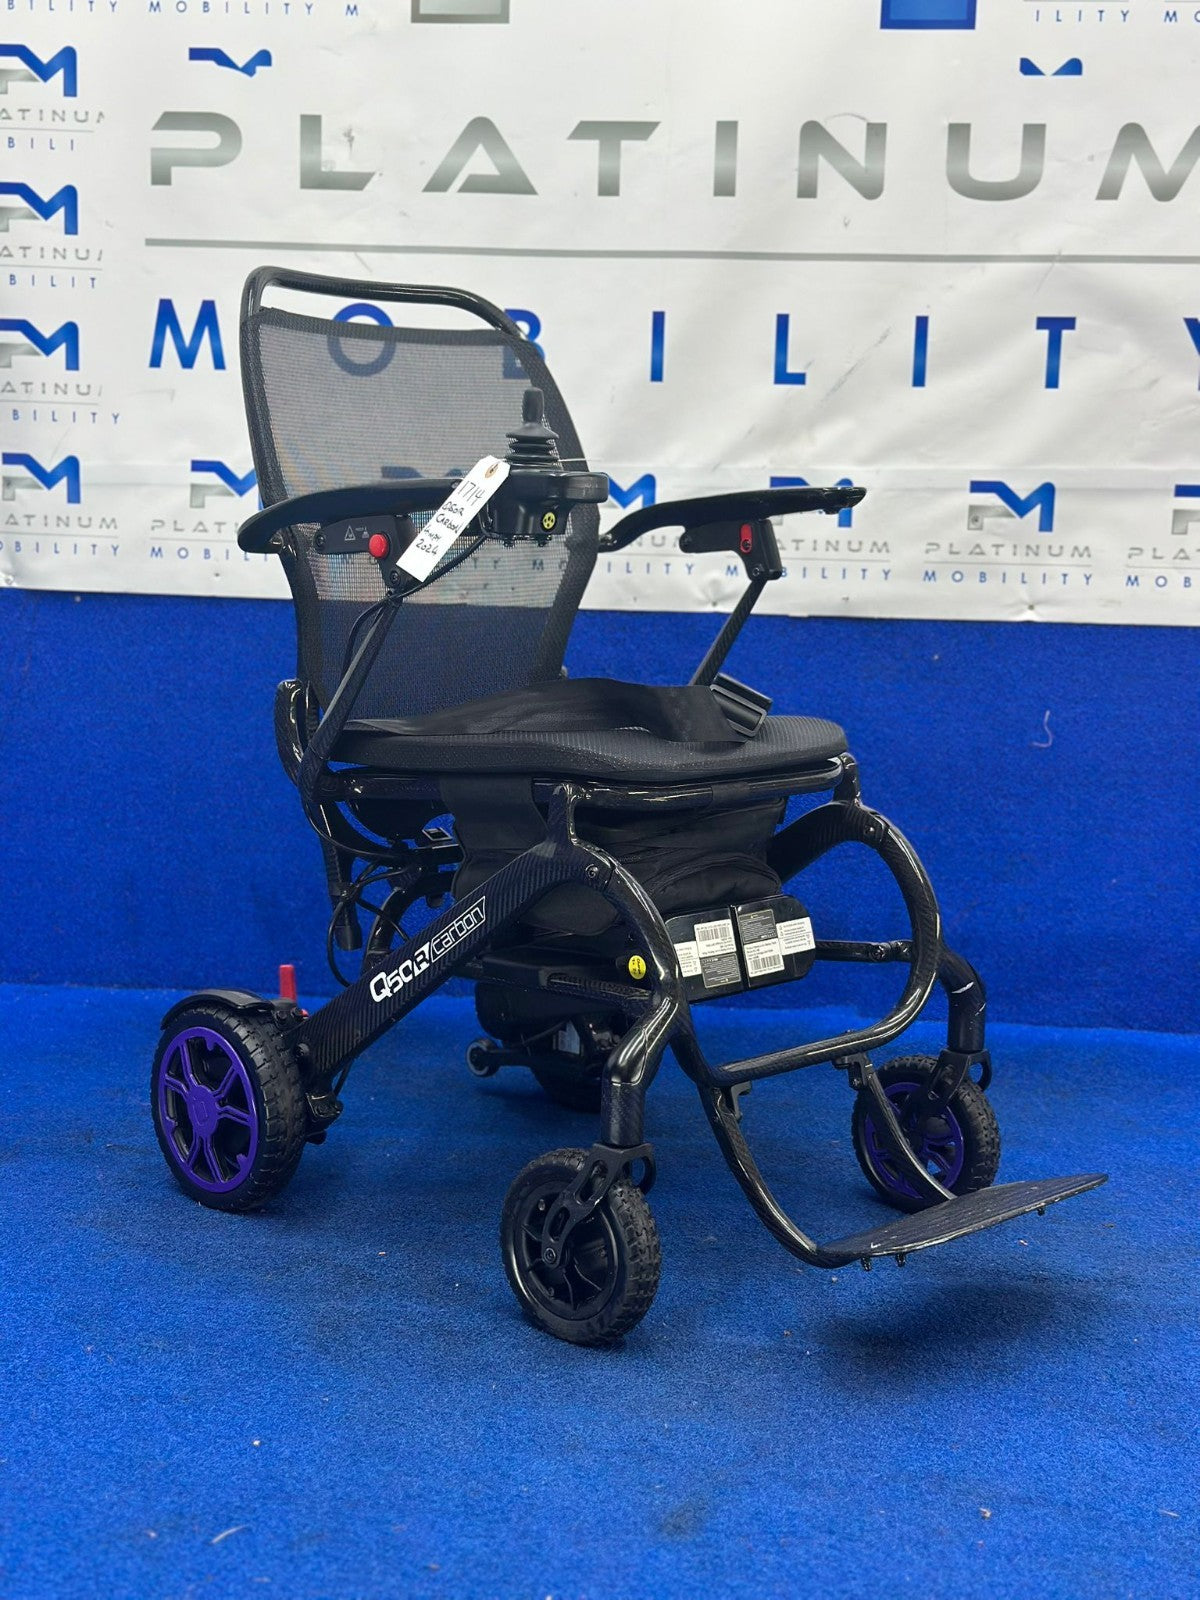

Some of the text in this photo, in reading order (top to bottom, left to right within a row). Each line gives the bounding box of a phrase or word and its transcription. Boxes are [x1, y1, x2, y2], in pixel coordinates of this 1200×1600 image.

[149, 1, 314, 16] MOBILITY
[151, 111, 1200, 202] PLATINUM
[0, 382, 102, 397] ATINU
[0, 541, 120, 556] BILITY
[416, 539, 439, 555] 2024
[925, 543, 1092, 558] PLATINUM
[726, 565, 891, 581] MBILITY
[923, 570, 1093, 586] MOBILITY
